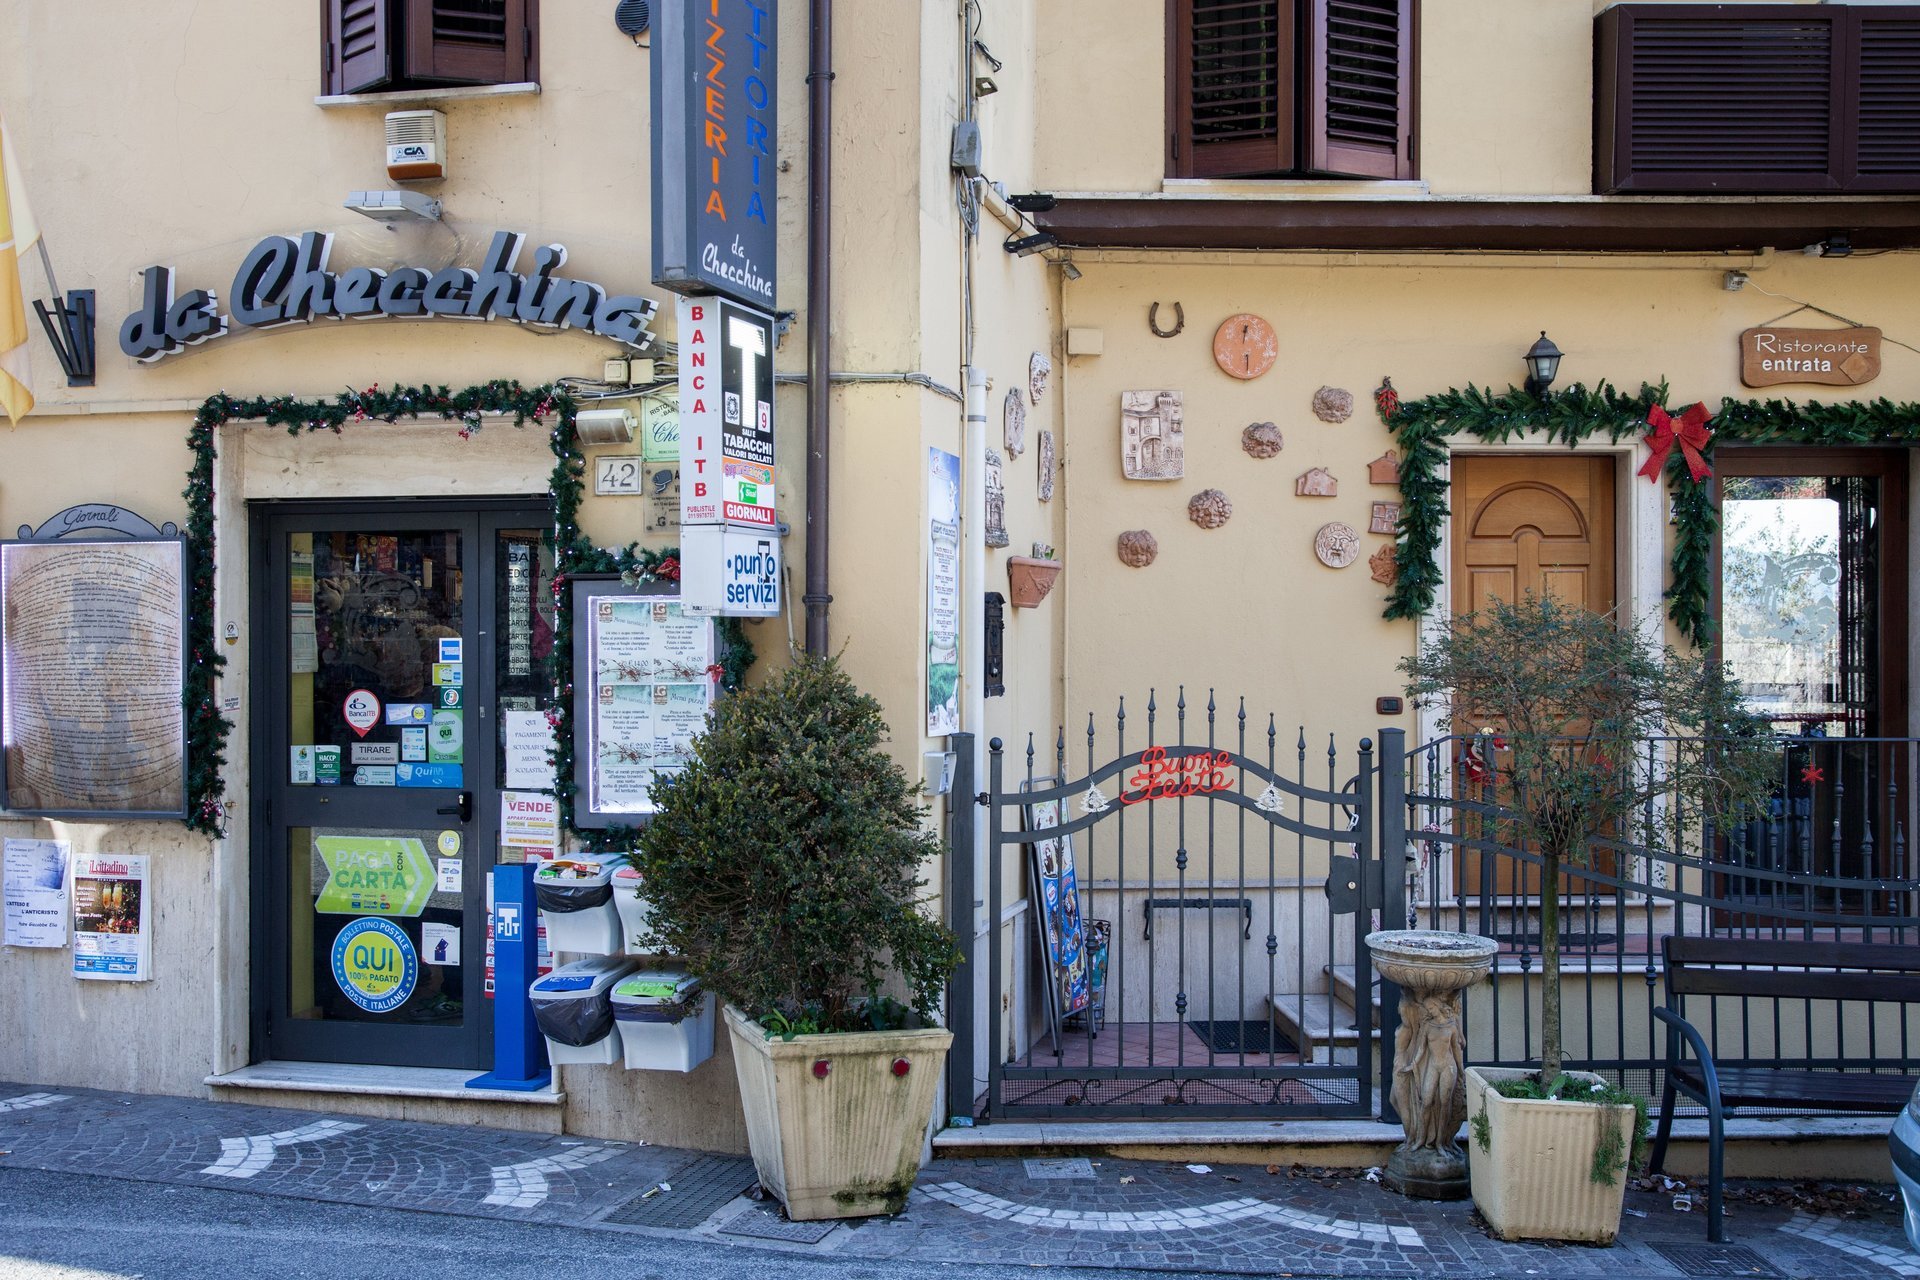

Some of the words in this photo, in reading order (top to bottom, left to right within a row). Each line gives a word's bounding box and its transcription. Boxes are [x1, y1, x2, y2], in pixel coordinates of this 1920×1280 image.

[731, 233, 744, 258] da
[702, 242, 772, 297] Checchina
[119, 265, 224, 360] da
[230, 231, 657, 350] Checchina
[1754, 333, 1868, 353] Ristorante
[691, 306, 706, 414] BANCA
[1762, 357, 1831, 372] entrata
[724, 433, 772, 456] TABACCHI
[724, 447, 746, 459] VALORI
[748, 452, 772, 464] BOLLATI
[602, 463, 636, 488] 42
[694, 436, 707, 497] ITB
[60, 508, 120, 532] Giornali
[727, 503, 771, 522] GIORNALI
[508, 553, 538, 562] BAR
[727, 578, 776, 603] servizi
[440, 729, 452, 738] QUI
[359, 746, 391, 754] TIRARE
[1141, 746, 1234, 777] Buone
[415, 767, 433, 777] Qui
[1120, 769, 1235, 805] Feste
[509, 801, 554, 813] VENDE
[335, 850, 394, 869] PAGA
[335, 870, 407, 890] CARTA
[342, 922, 378, 943] BOLLETTINO
[380, 923, 409, 950] POSTALE
[354, 945, 394, 972] QUI
[350, 972, 368, 980] 100%
[370, 974, 399, 983] PAGATO
[345, 985, 367, 1007] POSTE
[371, 989, 406, 1009] ITALIANE
